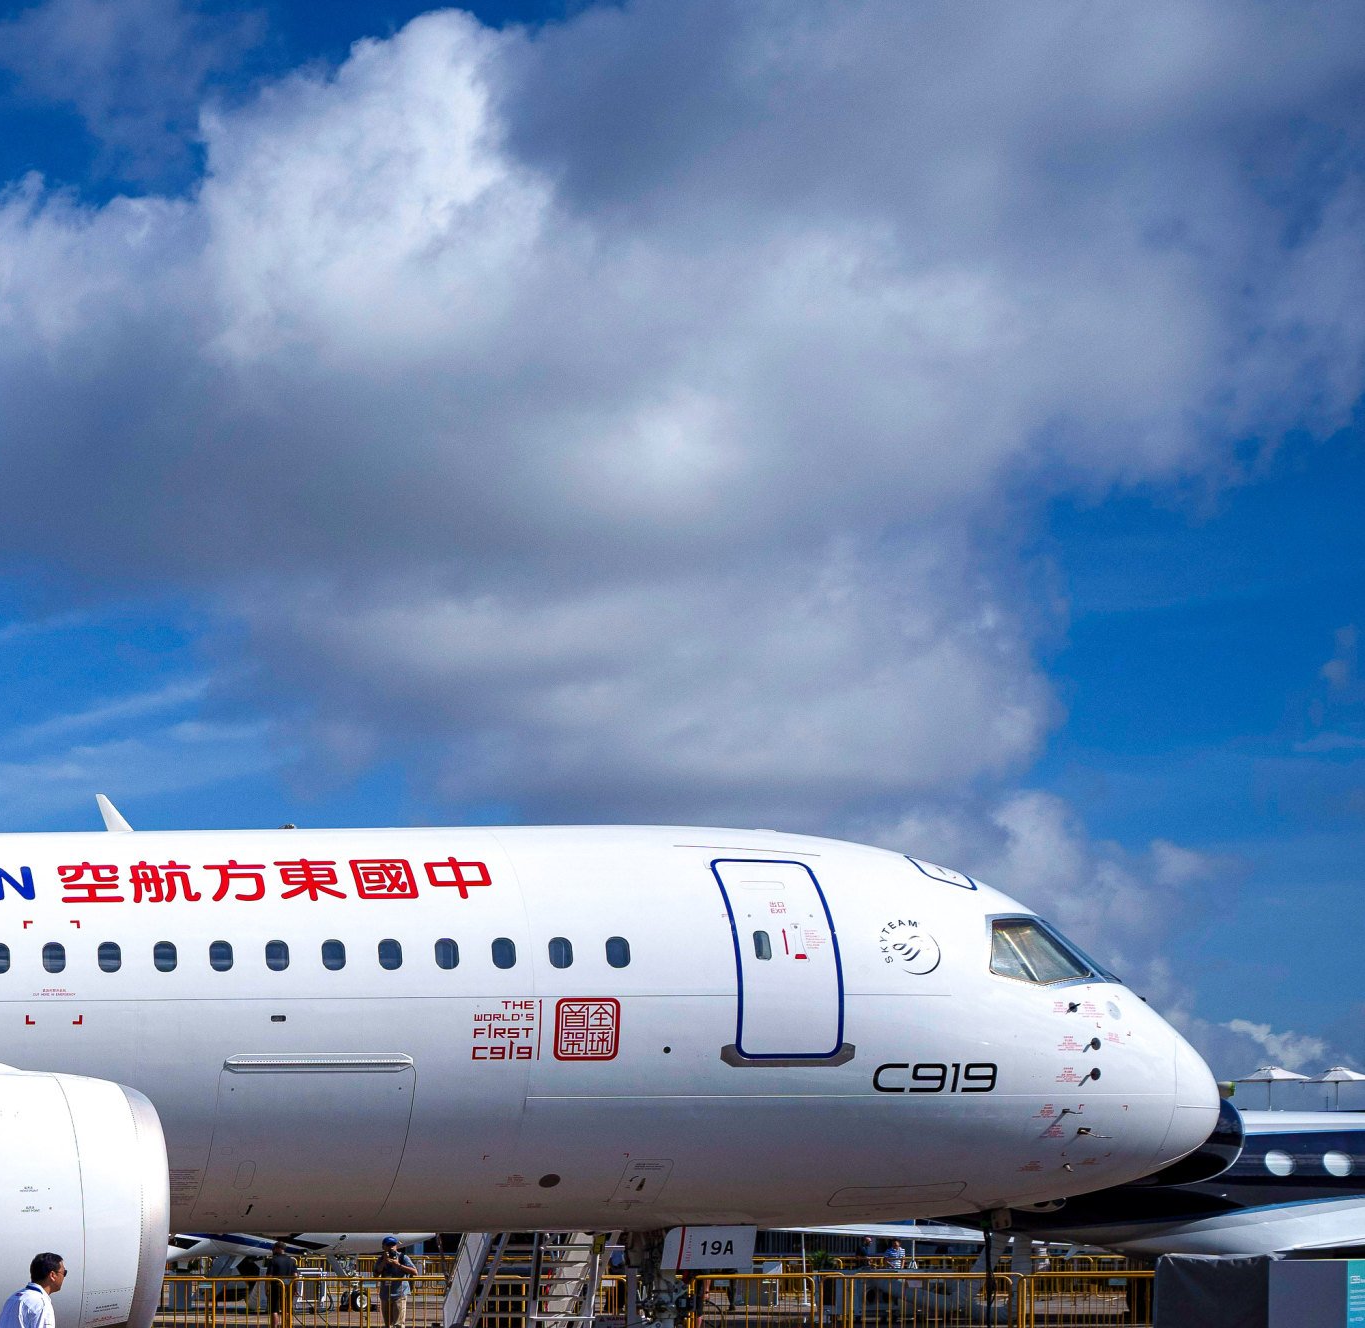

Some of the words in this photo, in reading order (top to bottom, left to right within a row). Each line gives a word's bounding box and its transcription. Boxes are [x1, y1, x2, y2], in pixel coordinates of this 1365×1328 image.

[879, 918, 920, 964] SKYTEAM
[502, 1000, 535, 1010] THE
[474, 1013, 535, 1022] WORLD'S
[473, 1023, 534, 1039] FIRST
[472, 1040, 534, 1061] C919
[873, 1063, 999, 1094] C919
[700, 1240, 735, 1257] 19A
